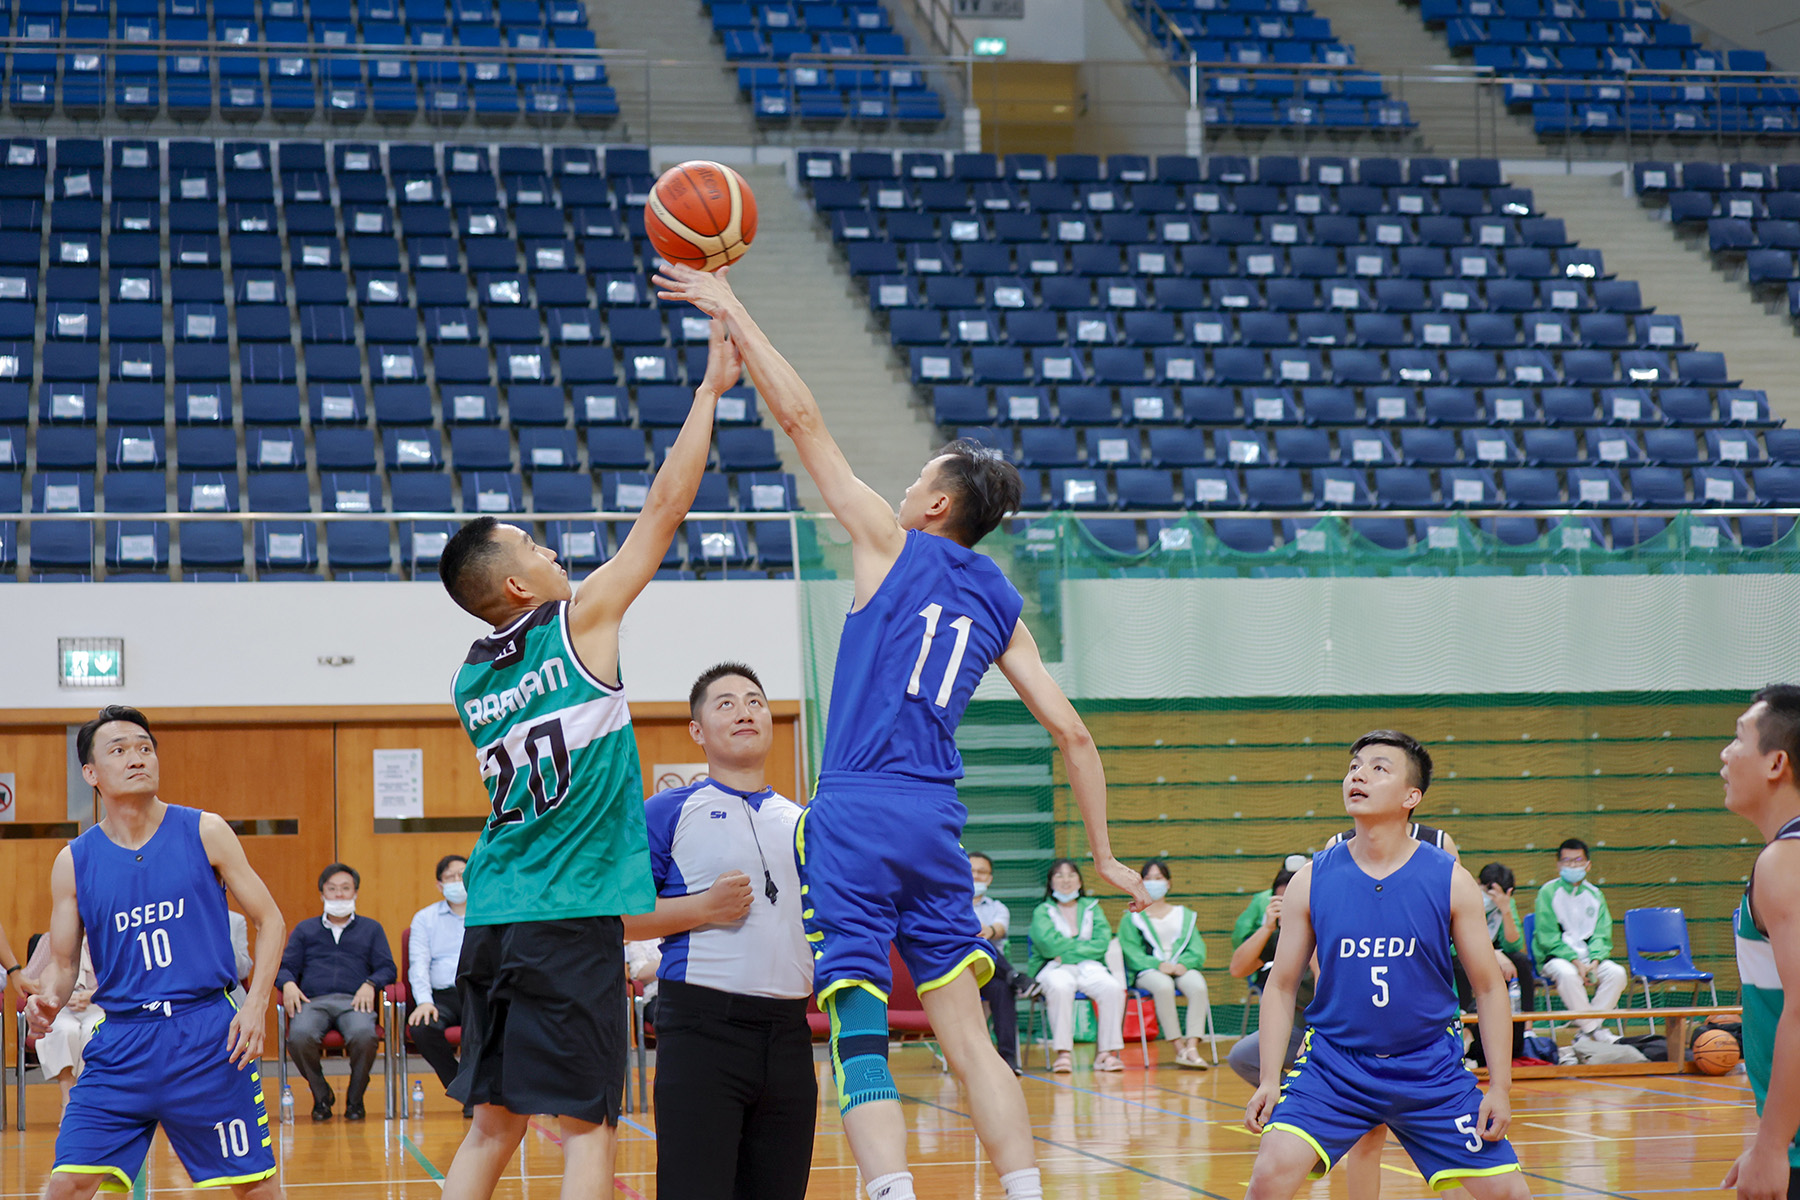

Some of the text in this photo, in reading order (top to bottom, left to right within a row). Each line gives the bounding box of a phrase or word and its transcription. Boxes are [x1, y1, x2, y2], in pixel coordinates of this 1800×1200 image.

[906, 602, 974, 708] 11
[483, 717, 572, 831] 20
[114, 897, 185, 933] DSEDJ
[136, 928, 172, 971] 10
[1339, 937, 1416, 958] DSEDJ
[1370, 965, 1390, 1008] 5
[213, 1118, 250, 1158] 10
[1454, 1113, 1483, 1153] 5
